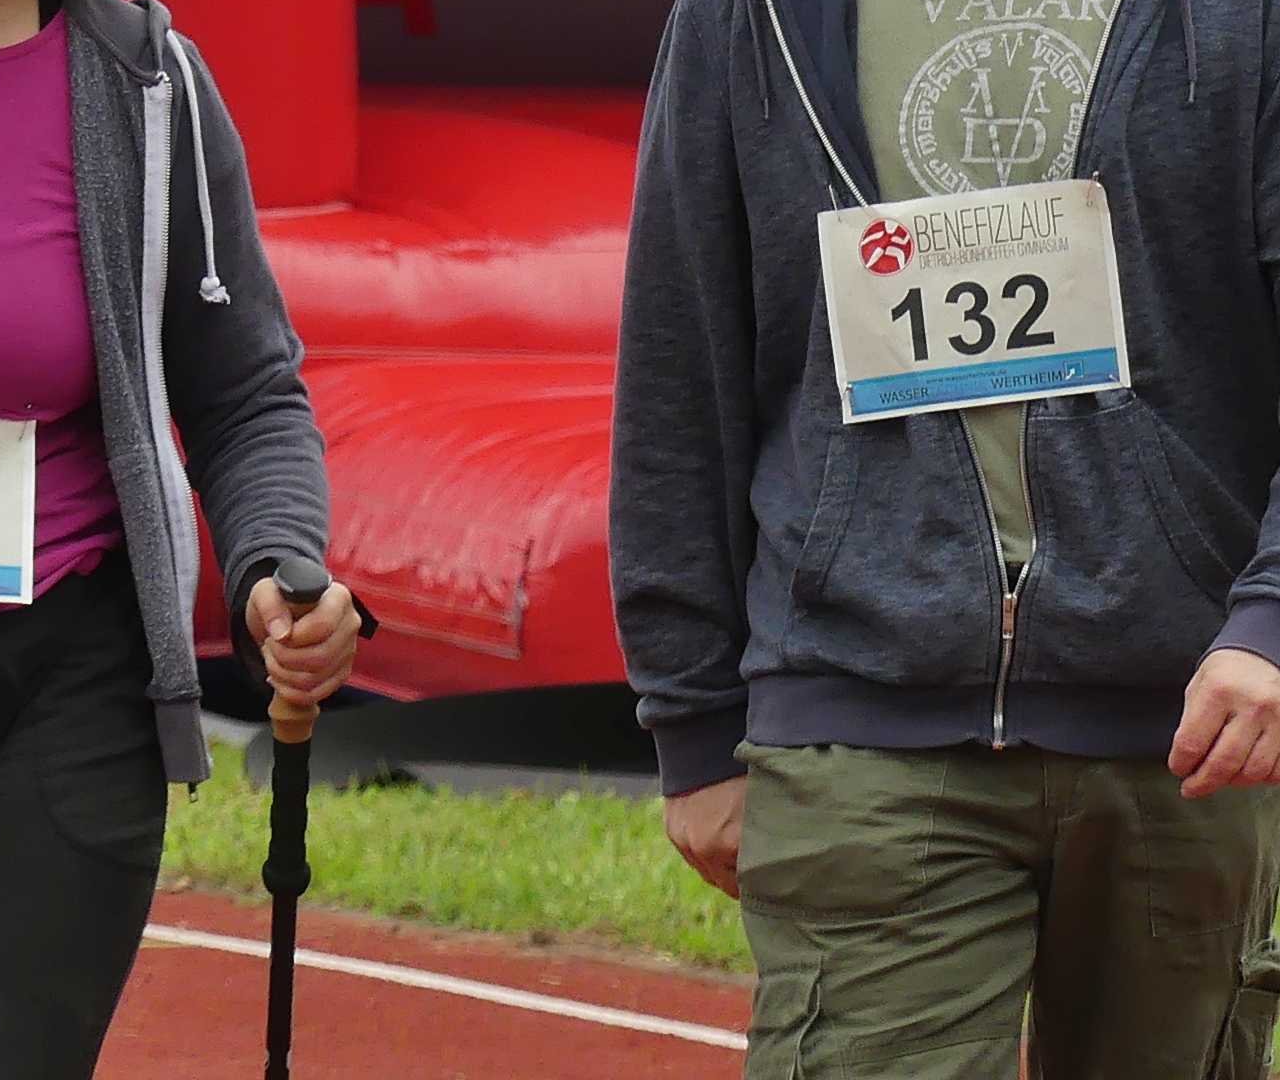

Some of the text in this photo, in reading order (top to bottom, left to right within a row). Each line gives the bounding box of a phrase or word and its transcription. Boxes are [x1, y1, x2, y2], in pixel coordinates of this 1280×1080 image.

[913, 197, 1065, 254] BENEFIZLAUF
[890, 274, 1056, 363] 132
[879, 386, 930, 404] WASSER
[990, 370, 1063, 390] WERTHEIM
